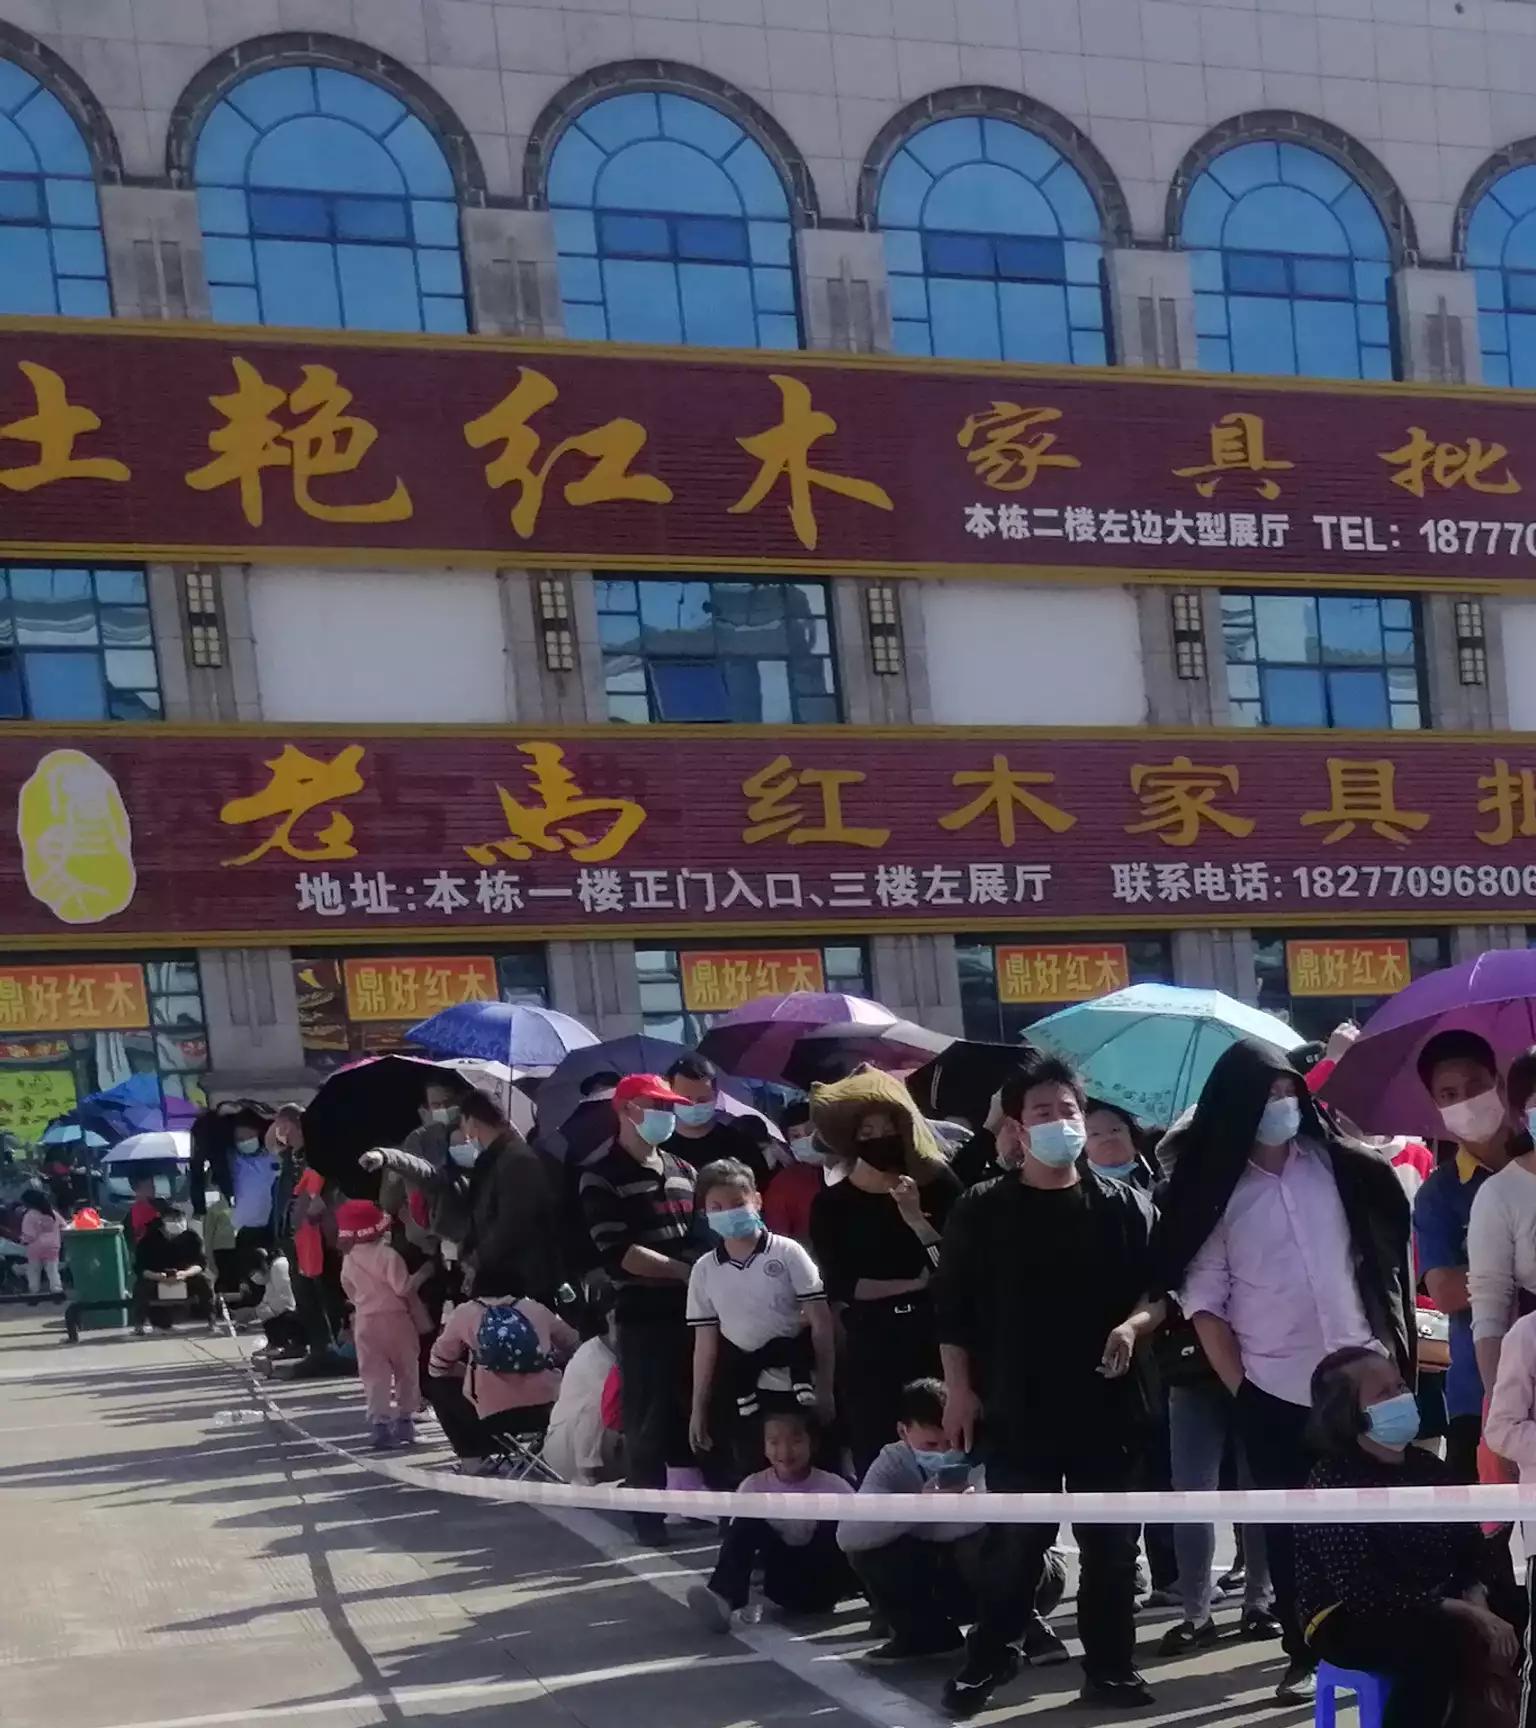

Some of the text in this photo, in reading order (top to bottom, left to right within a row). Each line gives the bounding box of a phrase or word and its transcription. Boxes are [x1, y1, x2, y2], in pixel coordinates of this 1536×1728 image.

[964, 503, 1290, 548] 本栋二楼左边大型展厅
[355, 964, 490, 1013] 鼎好红木
[692, 957, 816, 1003] 鼎好红木
[1004, 952, 1128, 994] 鼎好红木
[1296, 947, 1404, 991] 鼎好红木
[0, 972, 136, 1023] 鼎好红木
